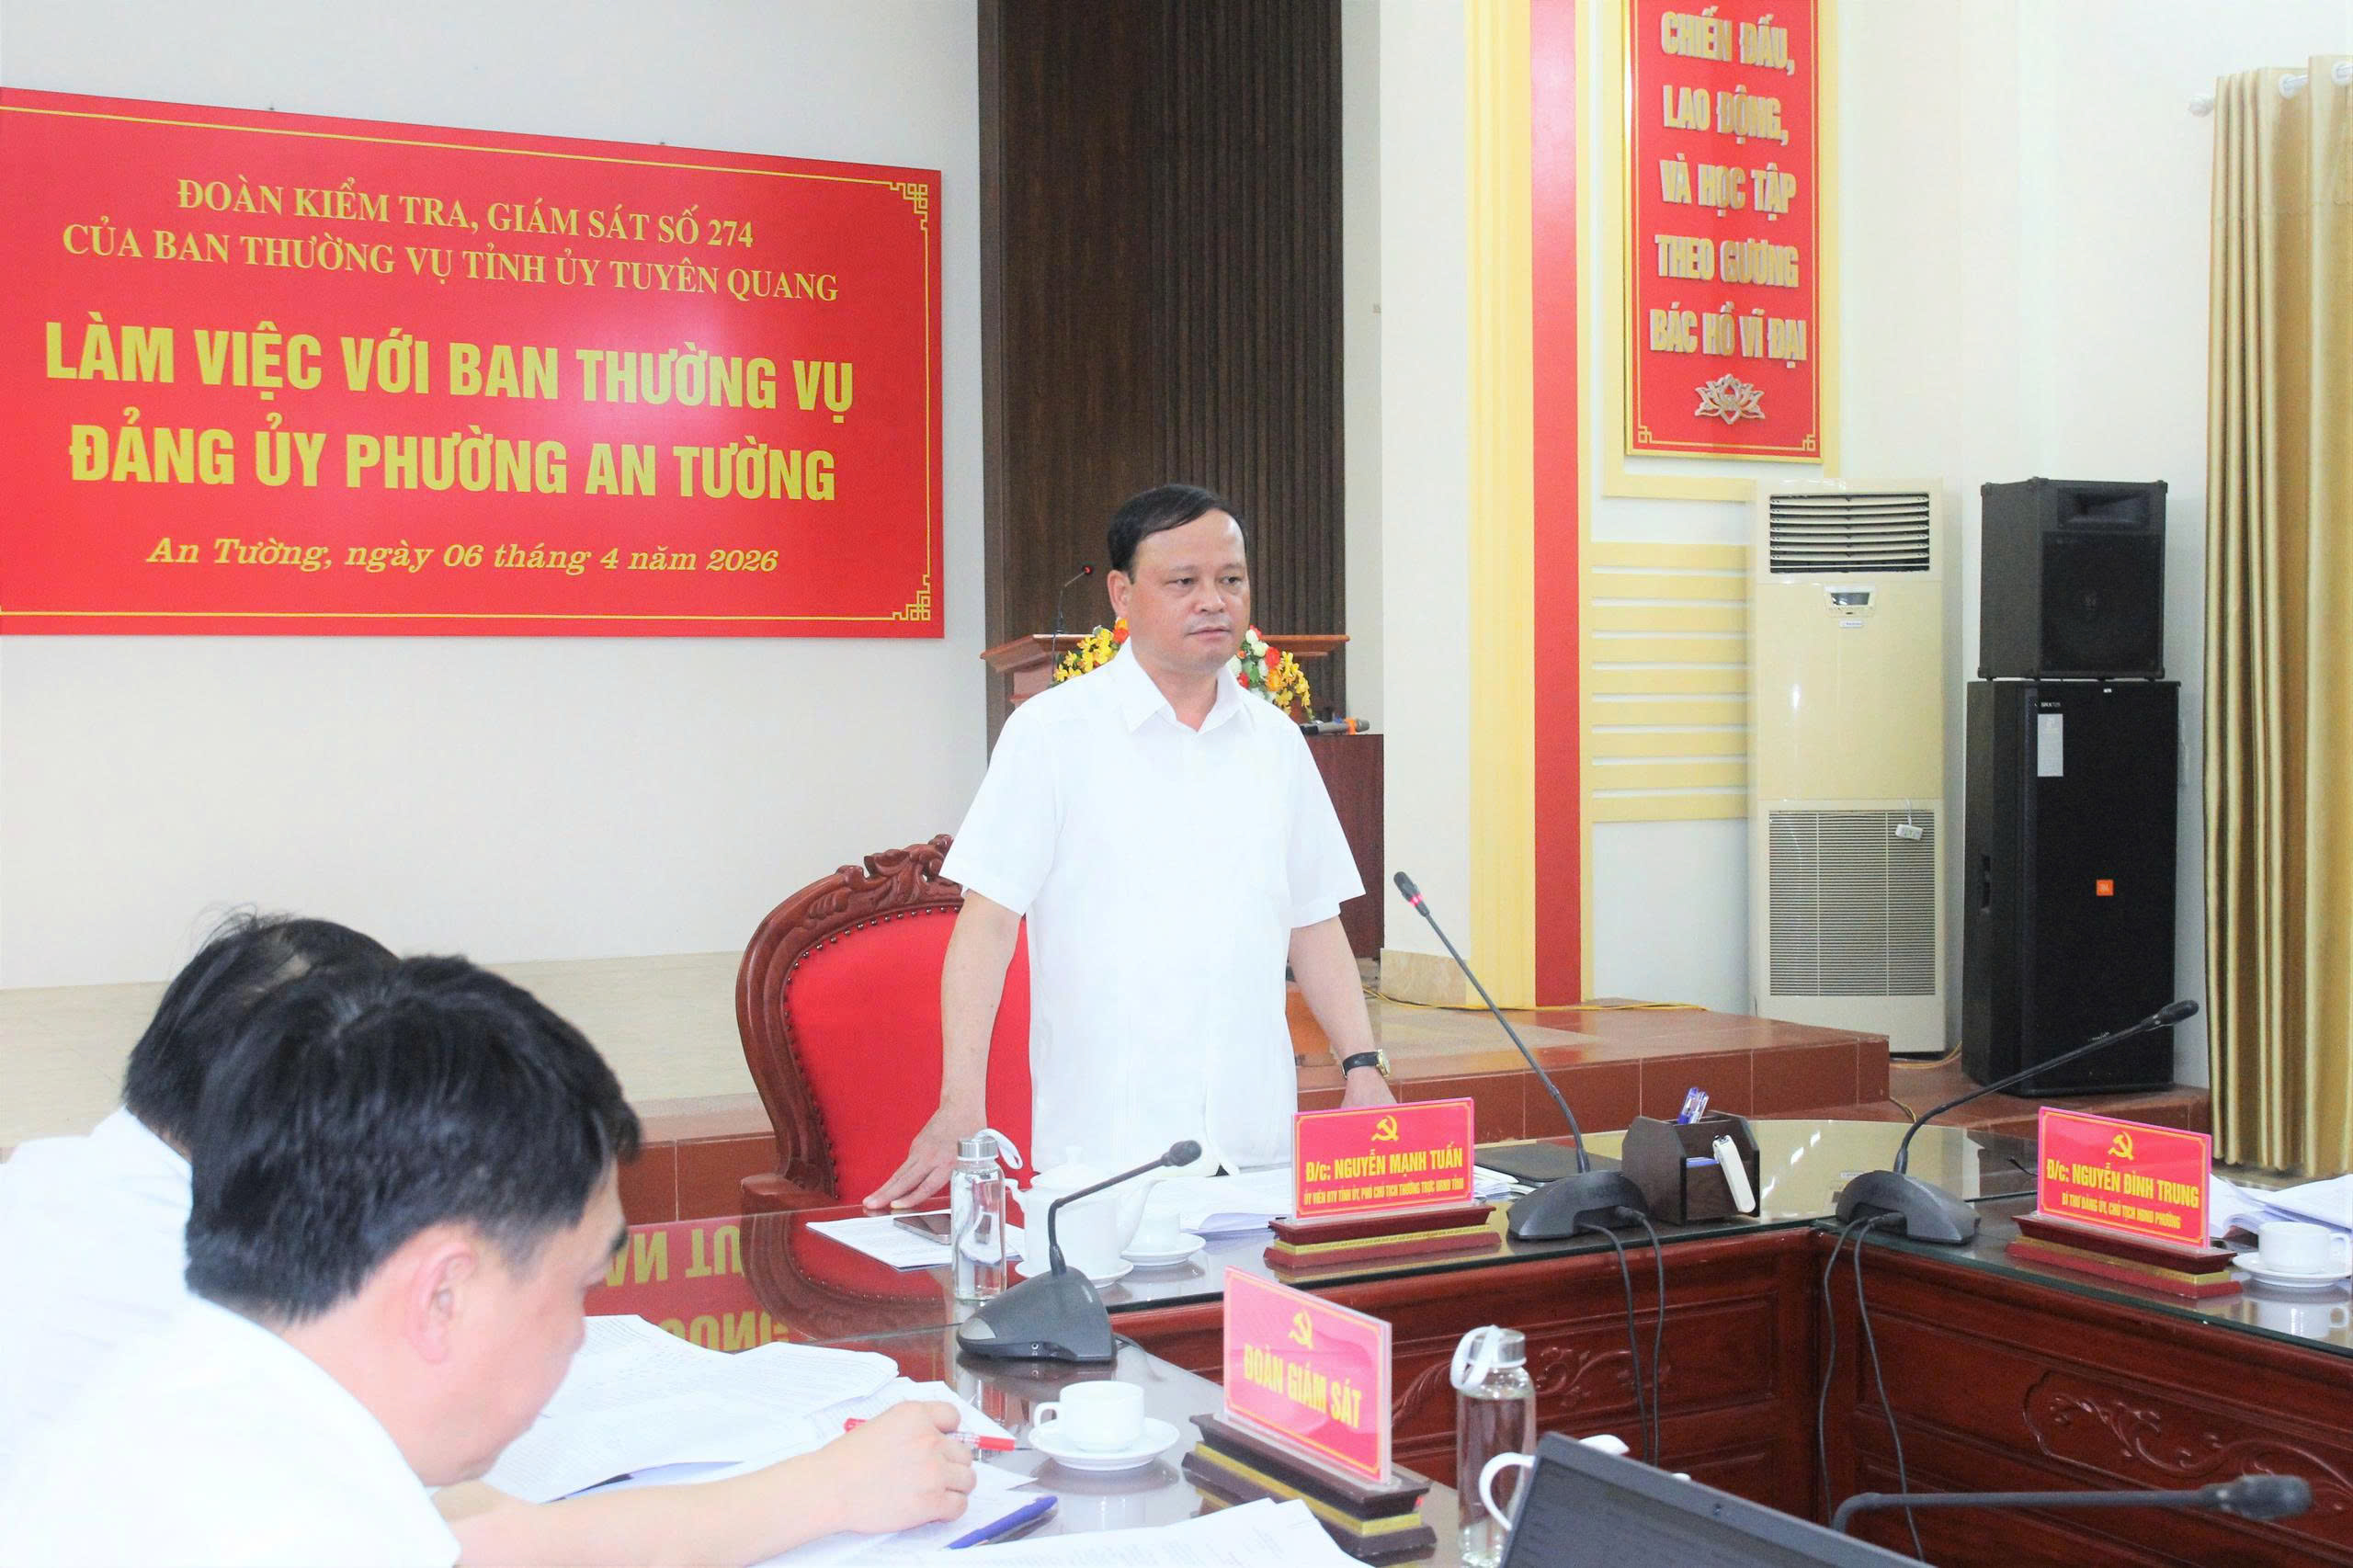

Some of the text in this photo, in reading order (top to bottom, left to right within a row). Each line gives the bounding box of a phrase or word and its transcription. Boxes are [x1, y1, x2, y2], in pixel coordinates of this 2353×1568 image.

[1661, 6, 1795, 75] CHIẾN ĐẤU,
[1663, 85, 1789, 146] LAO ĐỘNG,
[177, 175, 754, 248] ĐOÀN KIỂM TRA, GIÁM SÁT SỐ 274
[1659, 153, 1796, 222] VÀ HỌC TẬP
[63, 222, 838, 302] CỦA BAN THƯỜNG VỤ TỈNH ỦY TUYÊN QUANG
[1654, 234, 1714, 279] THEO
[47, 311, 854, 425] LÀM VIỆC VỚI BAN THƯỜNG VỤ
[1650, 301, 1698, 353] BÁC
[1768, 317, 1807, 369] ĐẠI
[69, 405, 835, 501] ĐẢNG ỦY PHƯỜNG AN TƯỜNG
[144, 537, 779, 575] An Tường, ngày 06 tháng 4 năm 2026
[1305, 1141, 1463, 1182] Đ/c: NGUYỄN MẠNH TUẤN
[2047, 1158, 2200, 1209] Đ/c: NGUYỄN ĐÌNH TRUNG
[1243, 1344, 1362, 1428] ĐOÀN GIÁM SÁT
